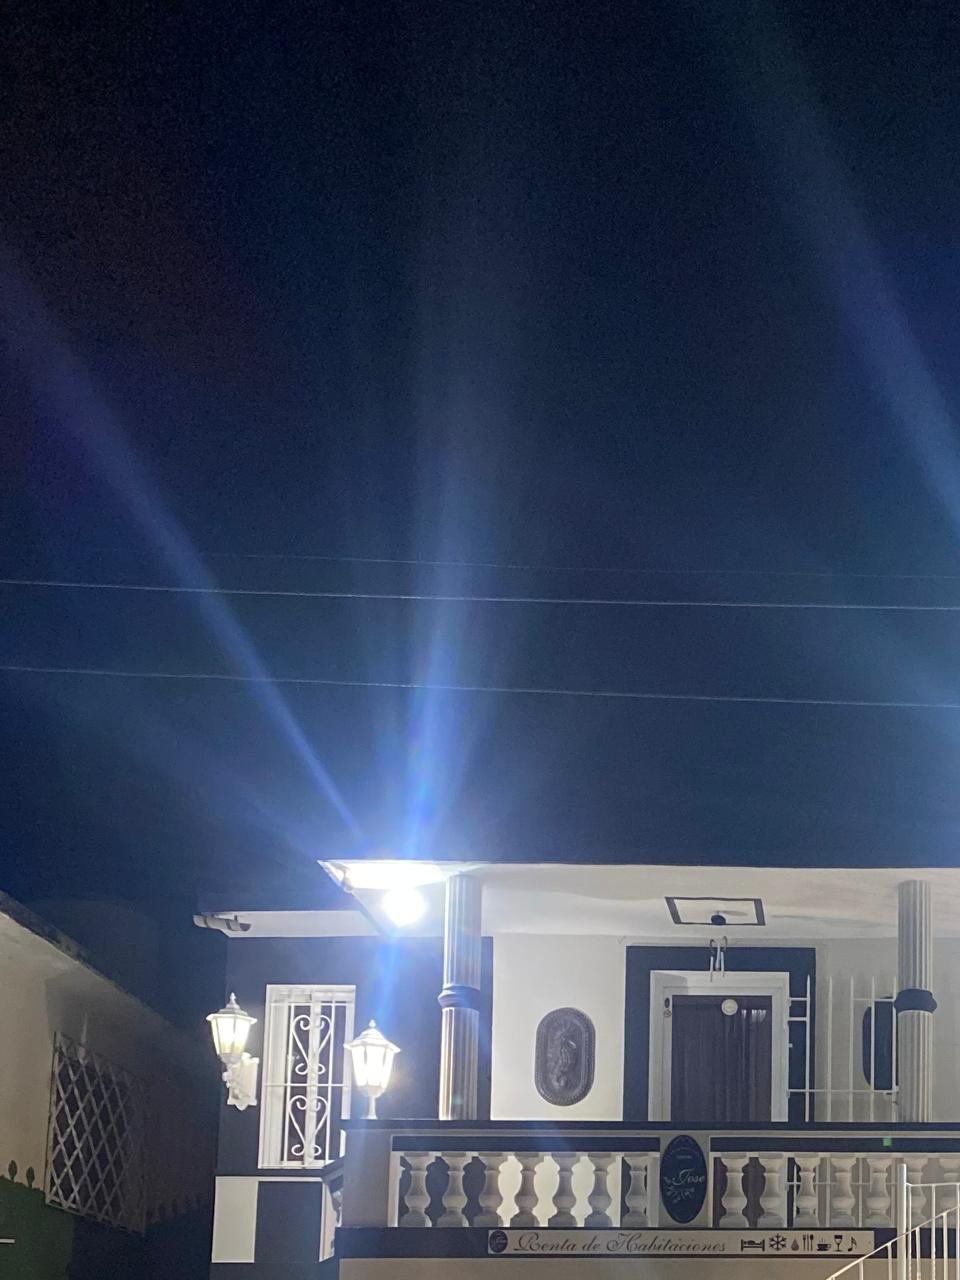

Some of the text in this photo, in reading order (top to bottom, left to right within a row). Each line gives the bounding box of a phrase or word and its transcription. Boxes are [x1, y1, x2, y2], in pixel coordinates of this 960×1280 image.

[513, 1232, 726, 1252] Renta de Habitaciones
